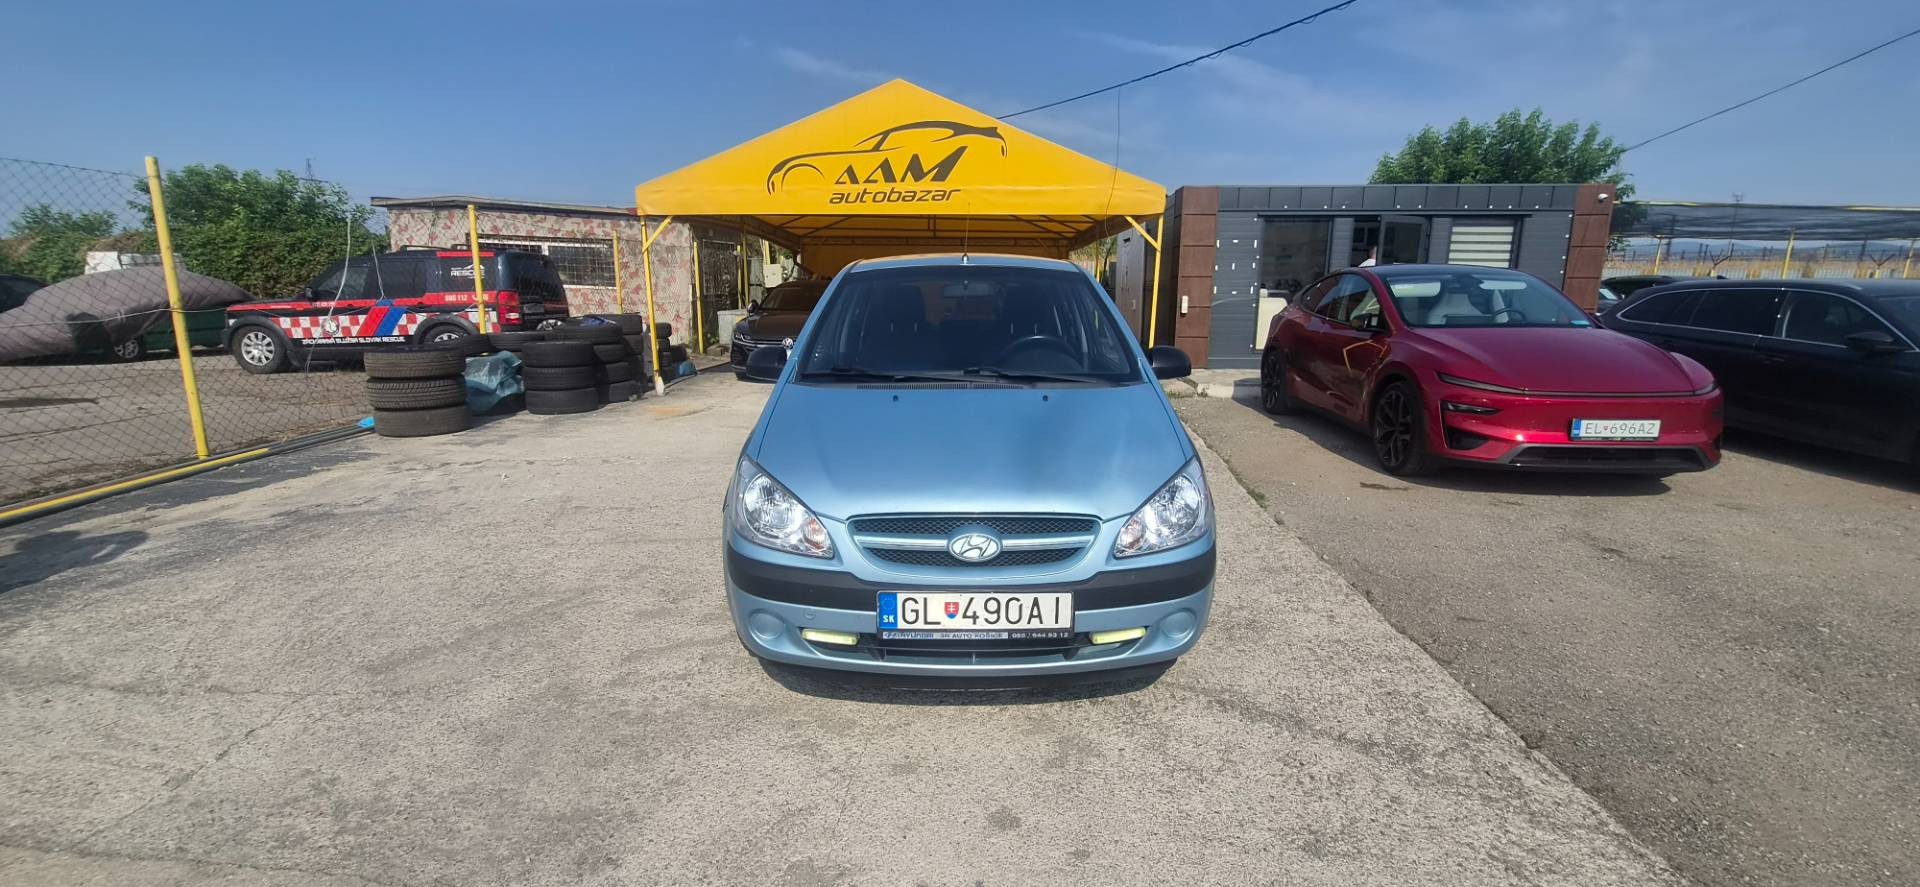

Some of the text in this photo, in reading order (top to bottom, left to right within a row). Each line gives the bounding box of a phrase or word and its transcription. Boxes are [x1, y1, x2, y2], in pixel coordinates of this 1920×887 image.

[834, 146, 968, 184] AAM
[829, 187, 961, 204] autobazar
[1584, 423, 1602, 435] EL
[1609, 423, 1656, 435] 696AZ
[901, 597, 1060, 625] GL 490AI
[882, 615, 895, 623] SK
[951, 631, 972, 639] AUTO
